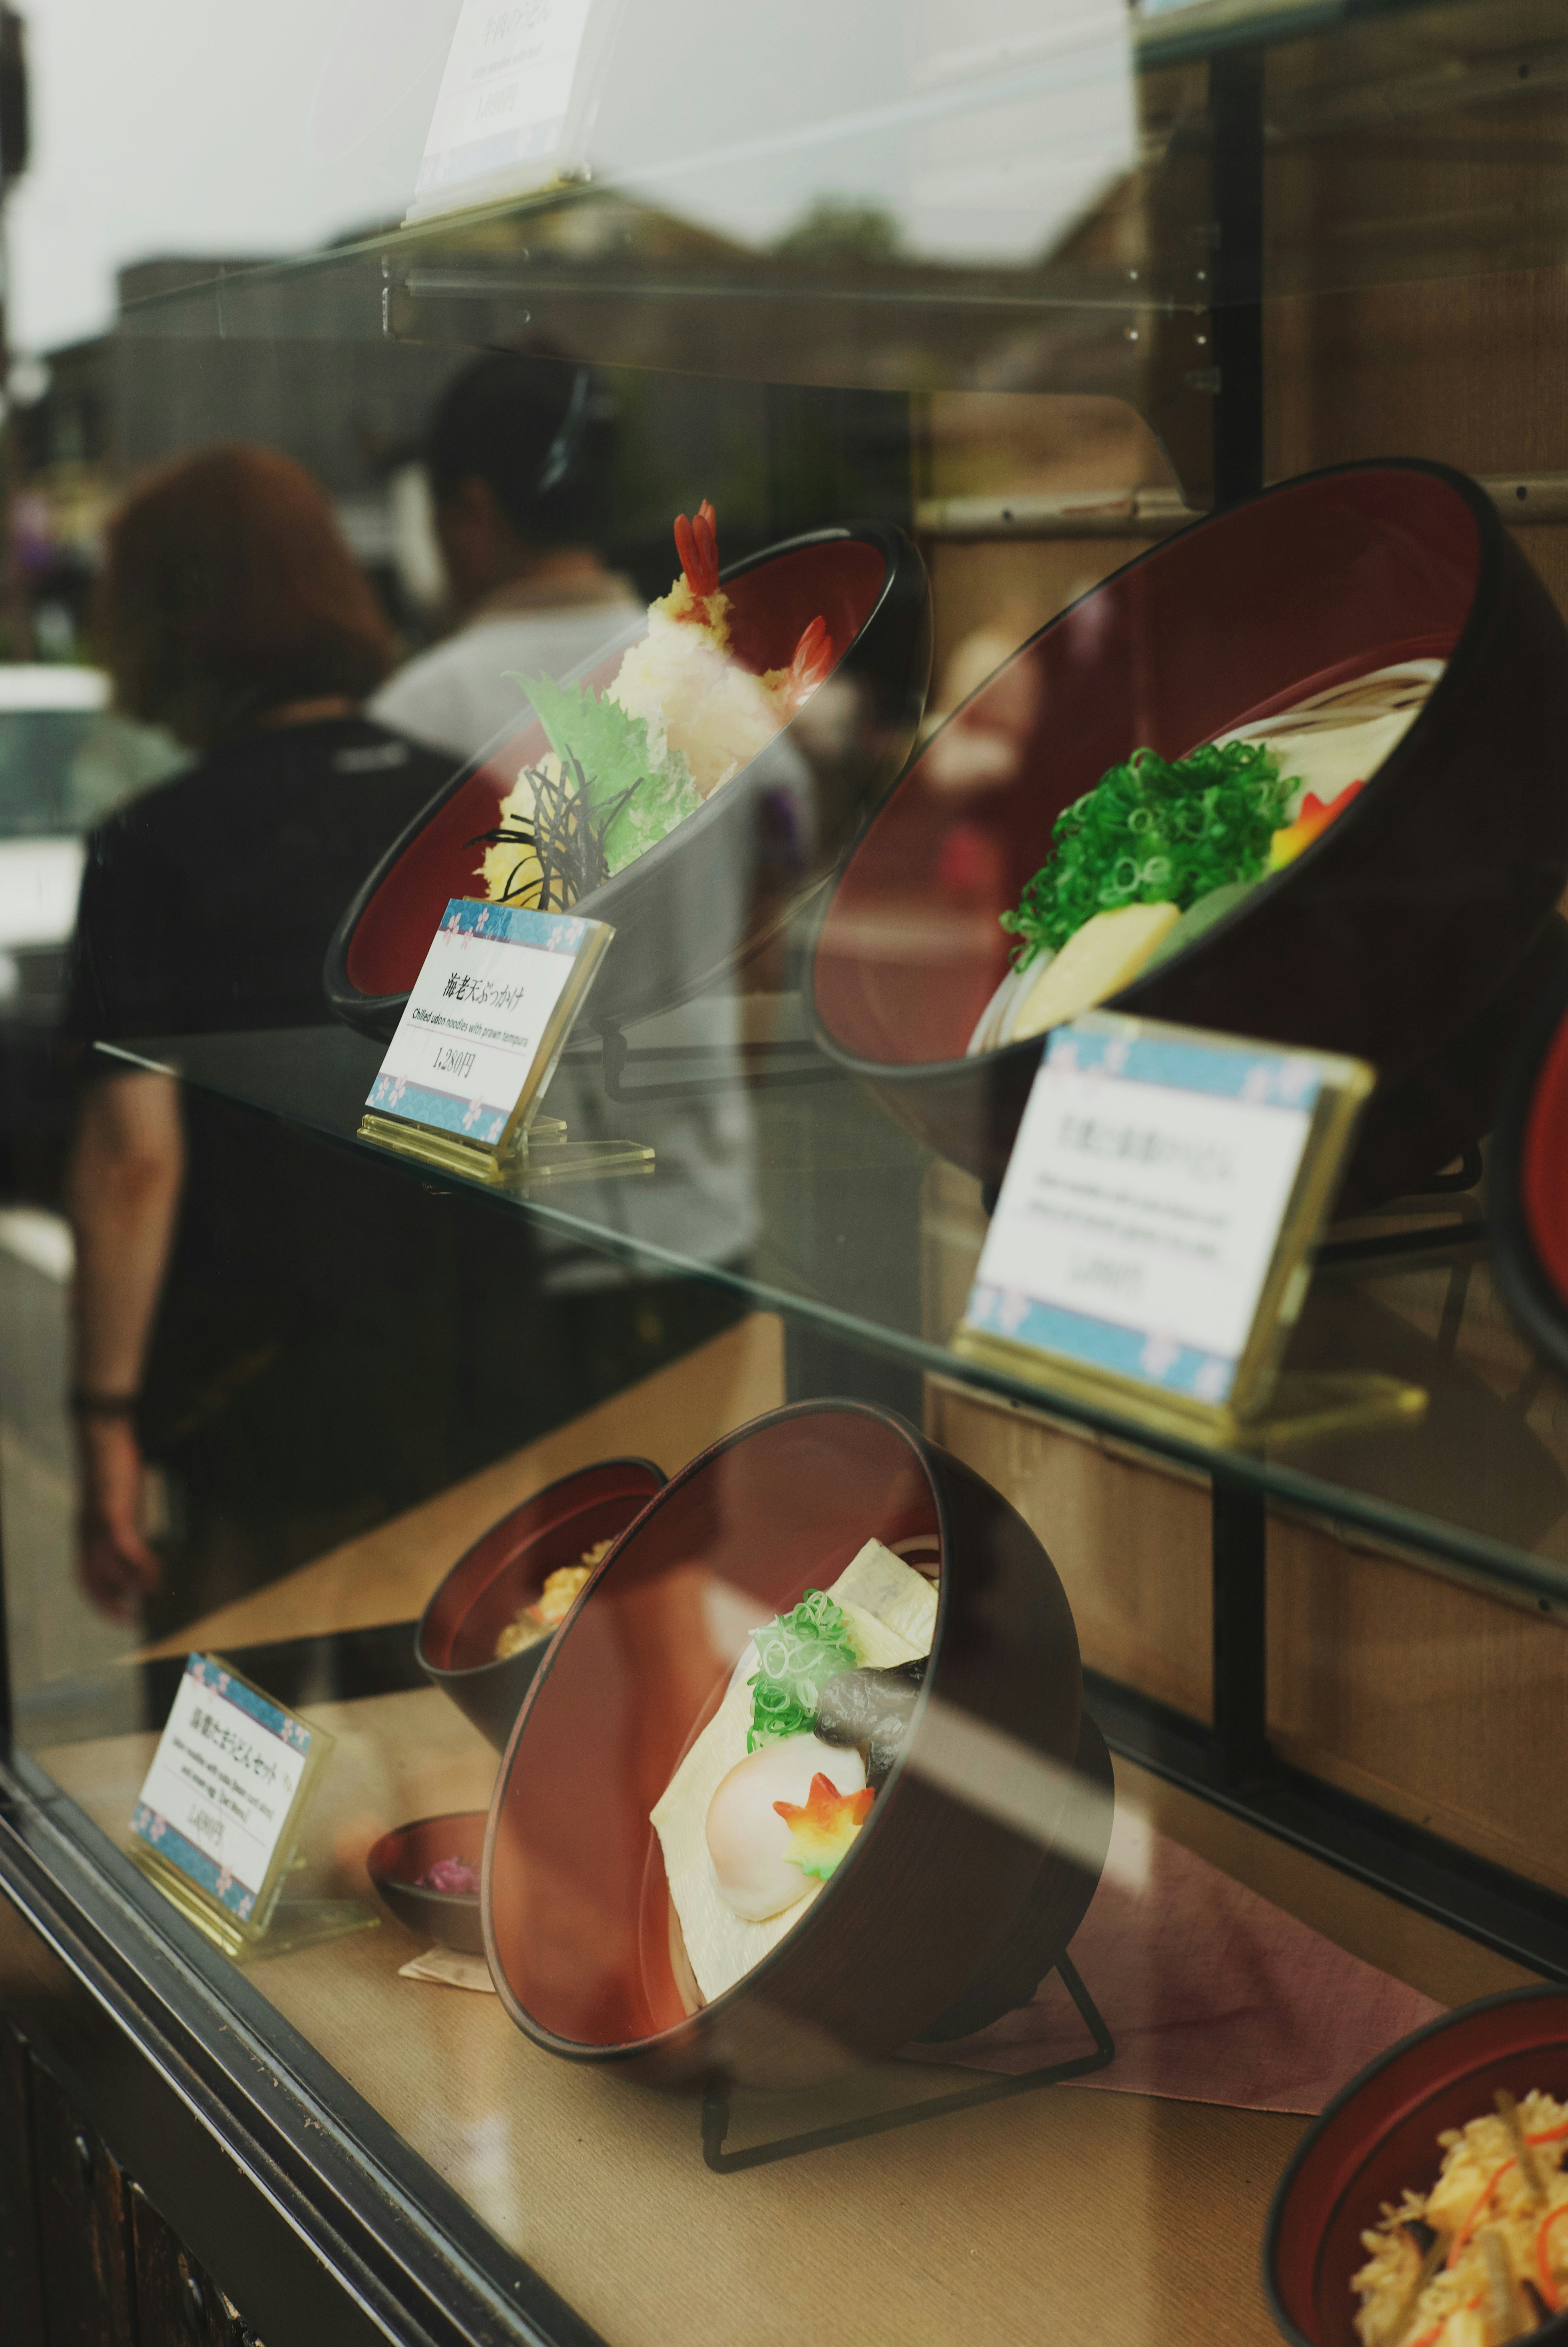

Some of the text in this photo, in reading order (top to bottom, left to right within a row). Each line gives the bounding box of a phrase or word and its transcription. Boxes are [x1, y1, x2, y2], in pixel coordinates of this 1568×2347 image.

[442, 972, 524, 1012] 海老天ぶっかけ
[412, 1008, 529, 1048] Chilled udon noodles with prawn tempura
[433, 1046, 476, 1078] 1,280円
